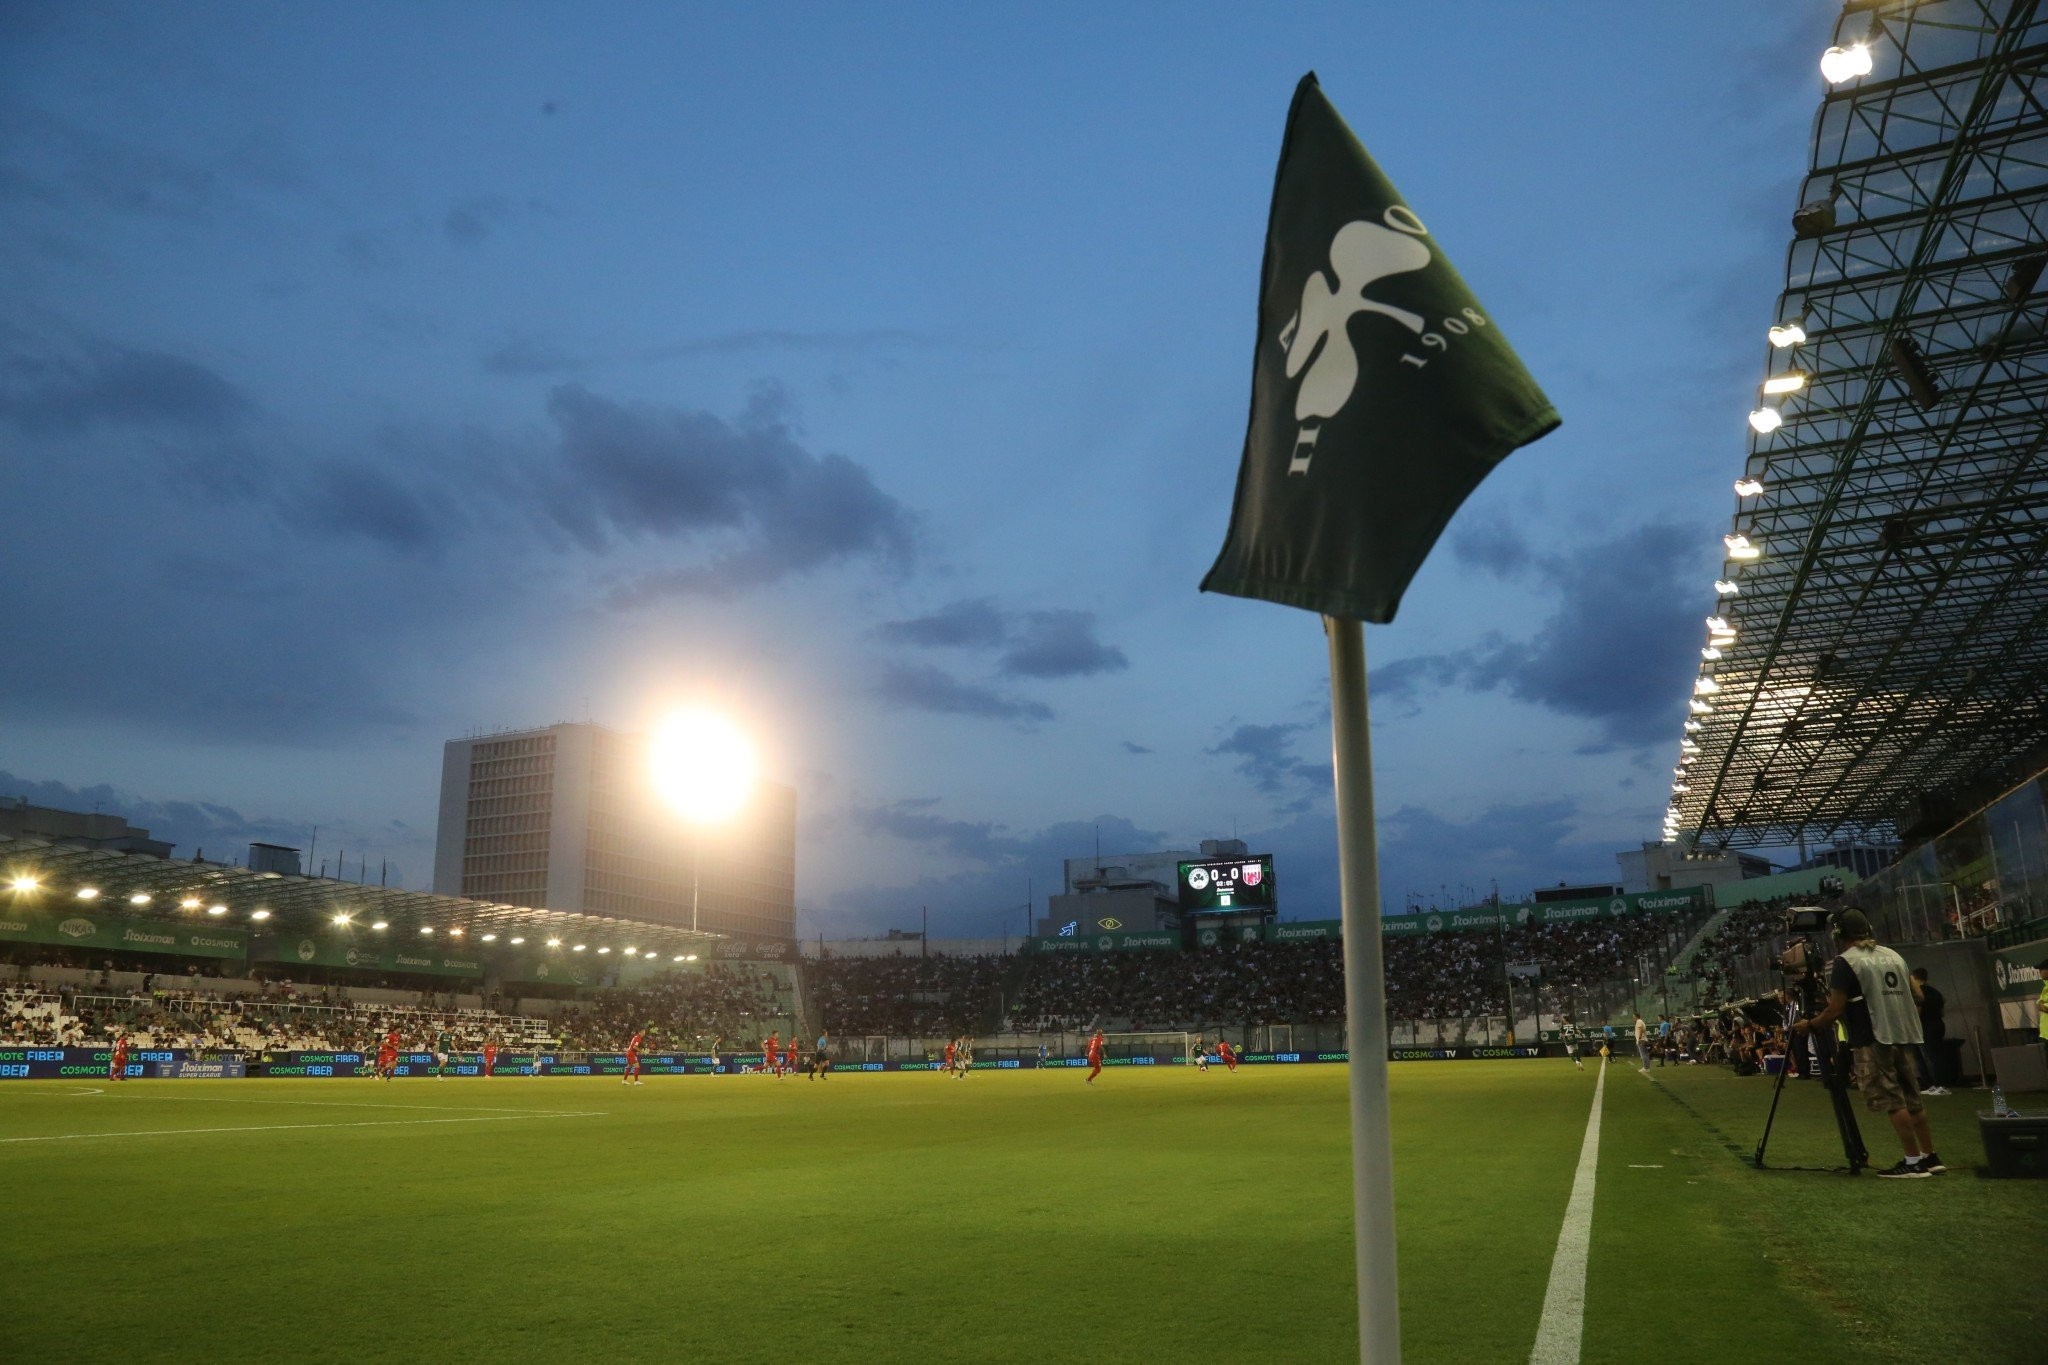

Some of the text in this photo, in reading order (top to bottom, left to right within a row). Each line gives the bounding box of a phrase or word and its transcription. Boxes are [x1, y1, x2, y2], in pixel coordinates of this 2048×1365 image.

[1401, 306, 1486, 369] 1908
[1211, 869, 1219, 881] 0
[1230, 868, 1239, 880] 0
[1543, 906, 1599, 919] Stoiximan
[123, 928, 175, 944] Stoiximan
[1276, 927, 1327, 939] Stoiximan
[200, 938, 239, 949] COSMOTE
[27, 1051, 65, 1061] FIBER
[94, 1052, 173, 1062] COSTE FIBER
[1402, 1050, 1456, 1059] COSMOTE TV
[1482, 1048, 1539, 1057] COSMOTE TV
[234, 1053, 245, 1062] TV
[300, 1054, 360, 1063] COSMOTE FIBER
[410, 1055, 432, 1063] FIBER
[1132, 1057, 1155, 1065] FIBER
[1276, 1054, 1300, 1062] FIBER
[180, 1061, 223, 1072] Stoiximan
[834, 1063, 884, 1071] COSMOTE FIBER
[998, 1060, 1020, 1068] FIBER
[60, 1066, 107, 1075] COSMOTE
[269, 1065, 334, 1076] COSMOTE FIBER
[427, 1065, 478, 1075] COSOTE FIBER
[493, 1066, 520, 1074] COSMOTE
[551, 1066, 591, 1075] COSMOTE FIBER
